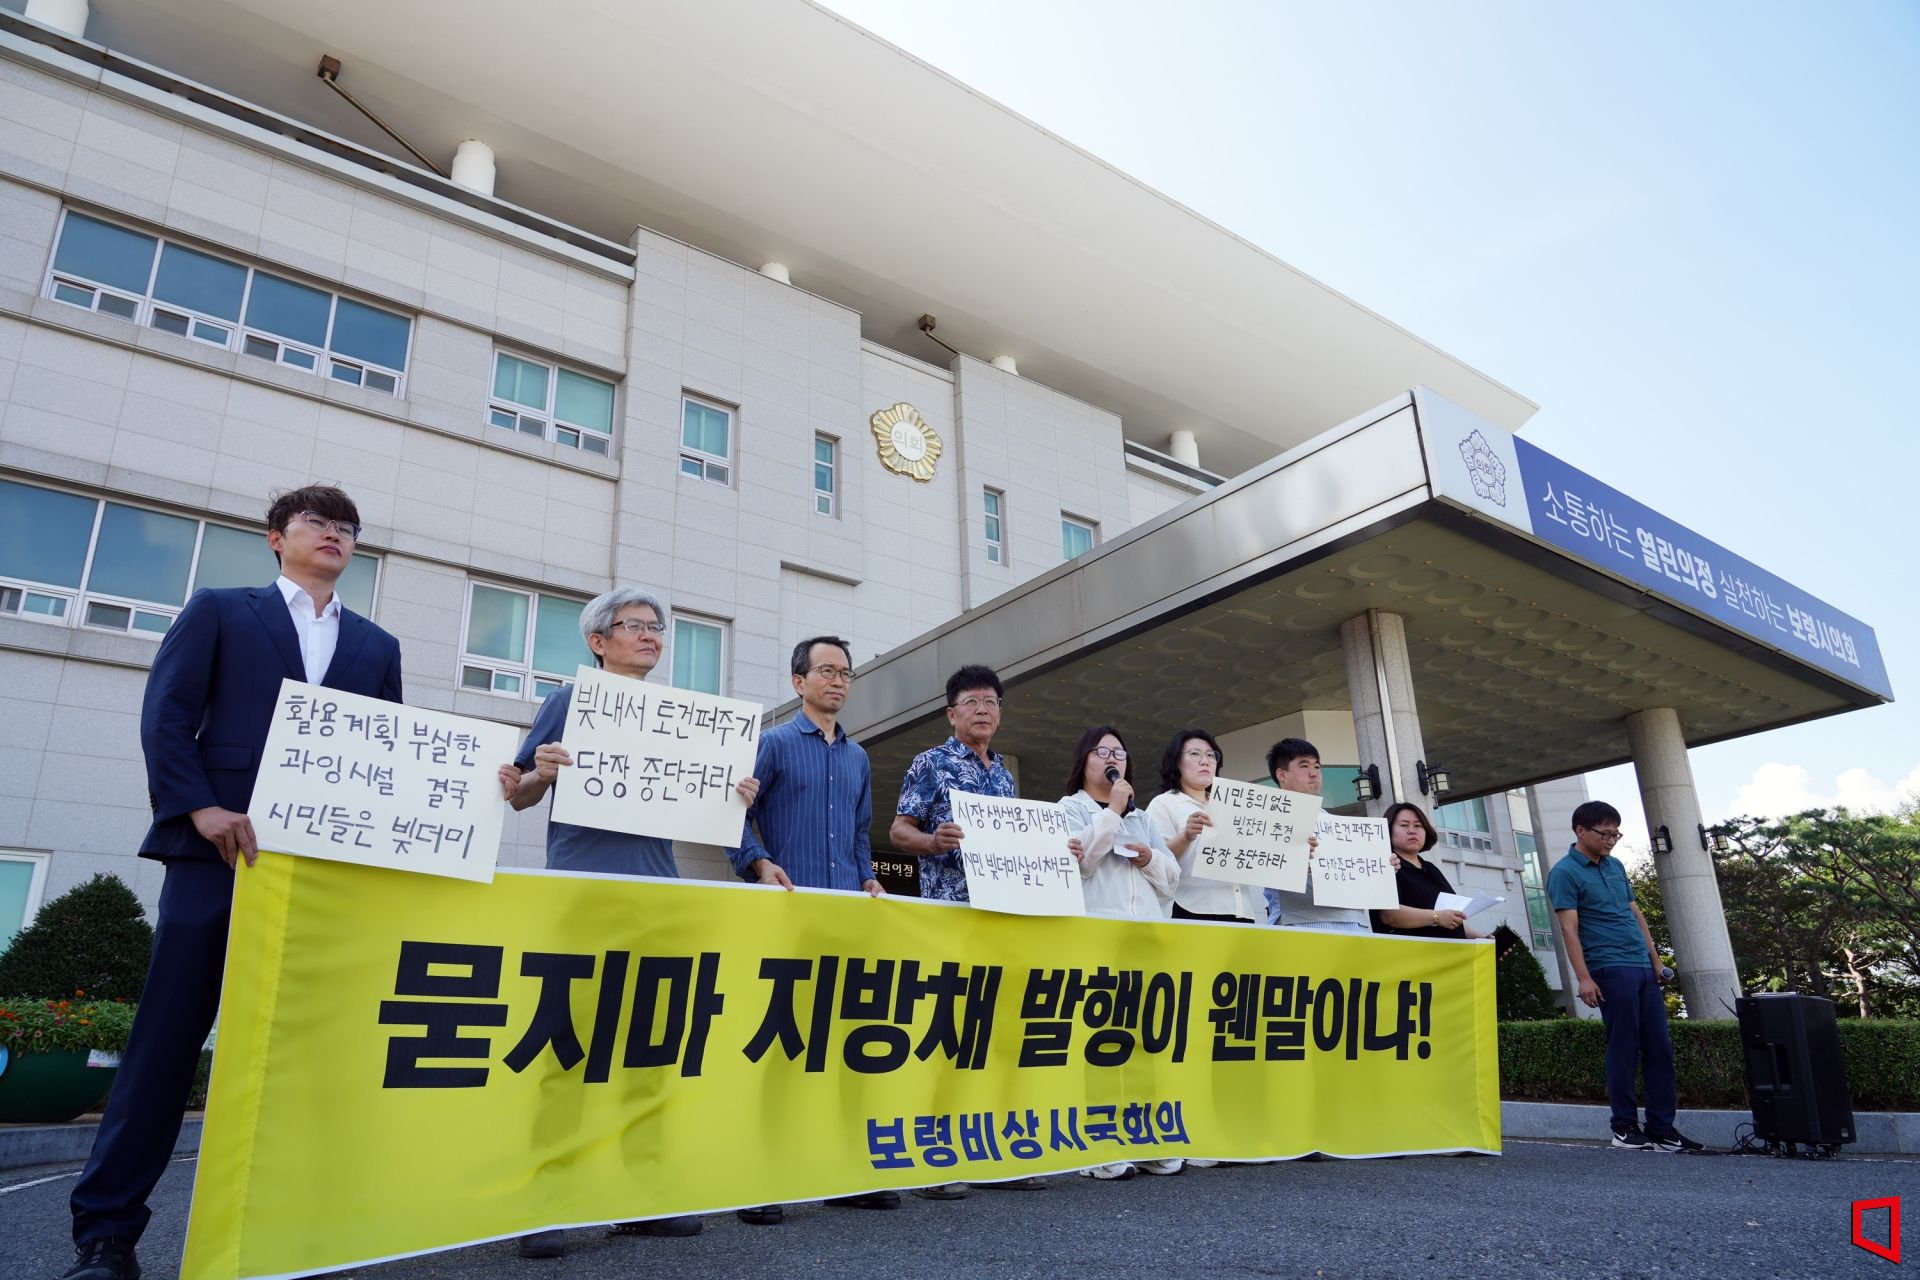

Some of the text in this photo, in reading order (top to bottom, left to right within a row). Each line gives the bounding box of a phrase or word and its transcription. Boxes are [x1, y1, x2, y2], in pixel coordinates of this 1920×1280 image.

[1543, 482, 1861, 668] 소통하는 열린의정 실천하는 보령시의회
[577, 683, 756, 746] 빚내서 토건퍼주기
[408, 721, 481, 767] 부실한
[427, 778, 470, 810] 결국
[577, 751, 735, 802] 당장 중단하라
[268, 802, 475, 860] 시민들은 빚더미
[1233, 815, 1294, 843] 빚잔치 추경
[1201, 847, 1288, 869] 당장 중단하라
[378, 940, 1433, 1089] 묻지마 지방채 발행이 웬말이냐!
[867, 1100, 1191, 1170] 보령비상시국회의
